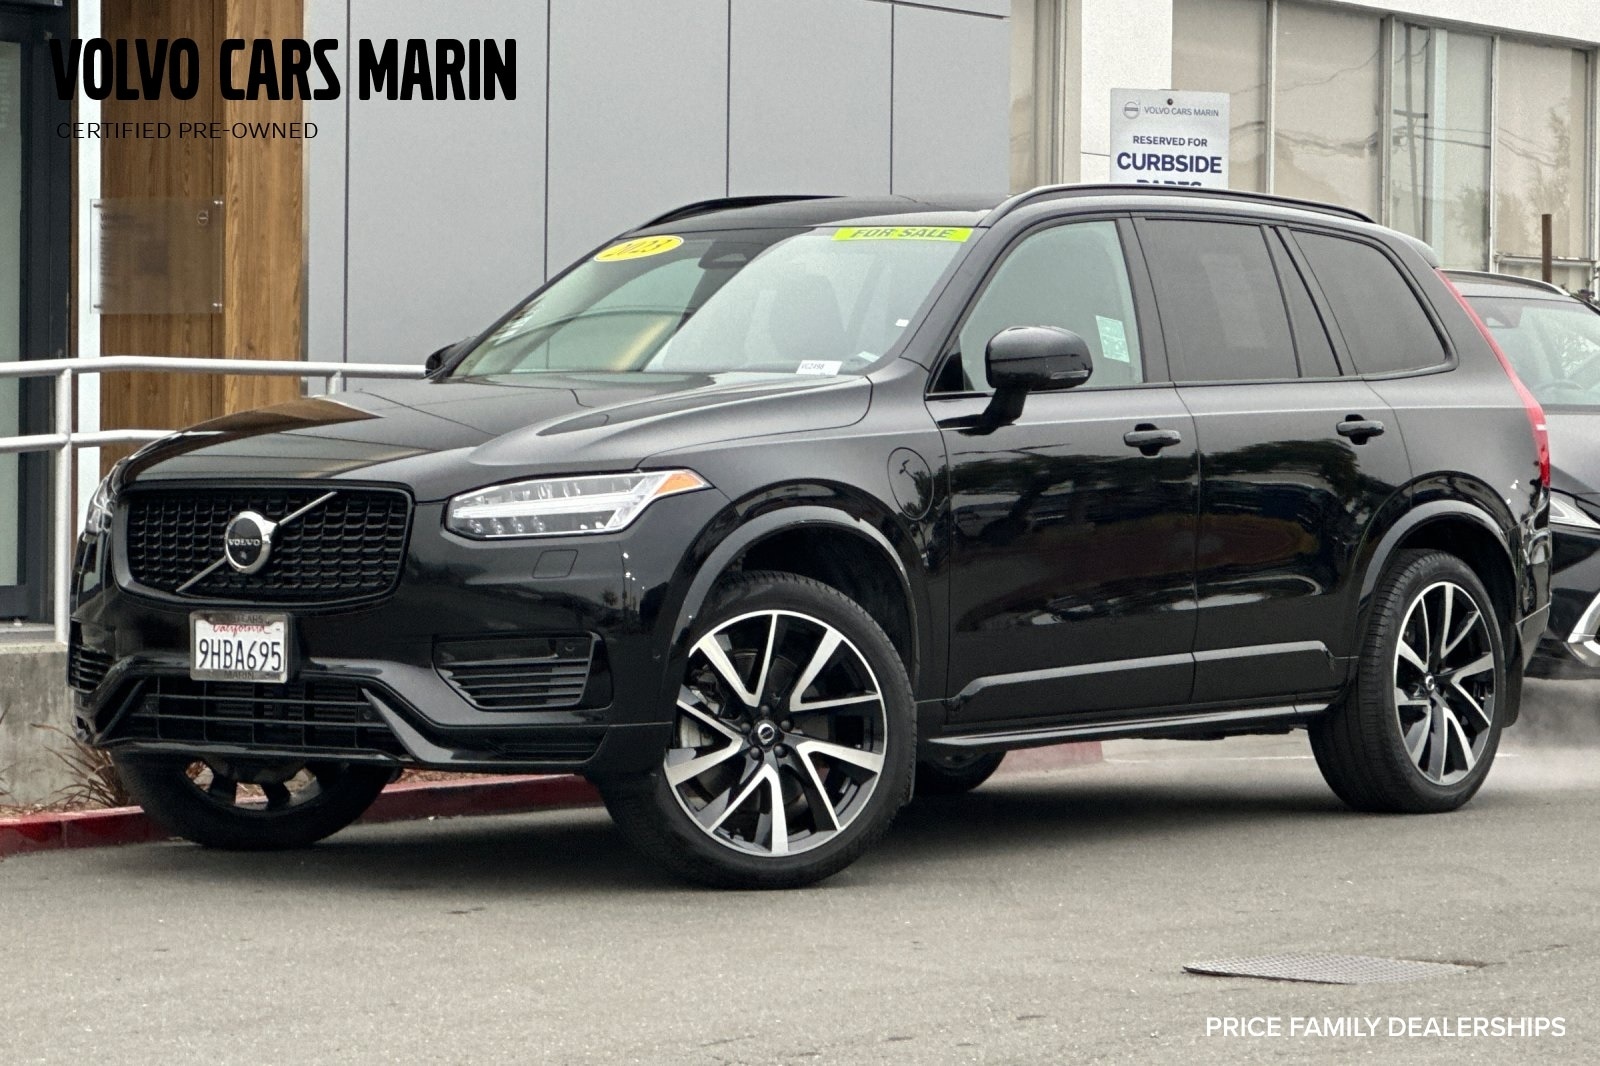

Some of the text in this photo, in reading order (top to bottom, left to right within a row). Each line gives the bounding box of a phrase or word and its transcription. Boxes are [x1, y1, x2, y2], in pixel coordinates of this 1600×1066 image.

[1144, 106, 1220, 117] VOLVO CARS MARIN
[1132, 135, 1208, 147] RESERVED FOR
[1116, 152, 1222, 173] CURBSIDE
[850, 227, 956, 239] FOR SALE
[228, 538, 261, 546] VOLVO
[199, 639, 281, 671] 9HBA695
